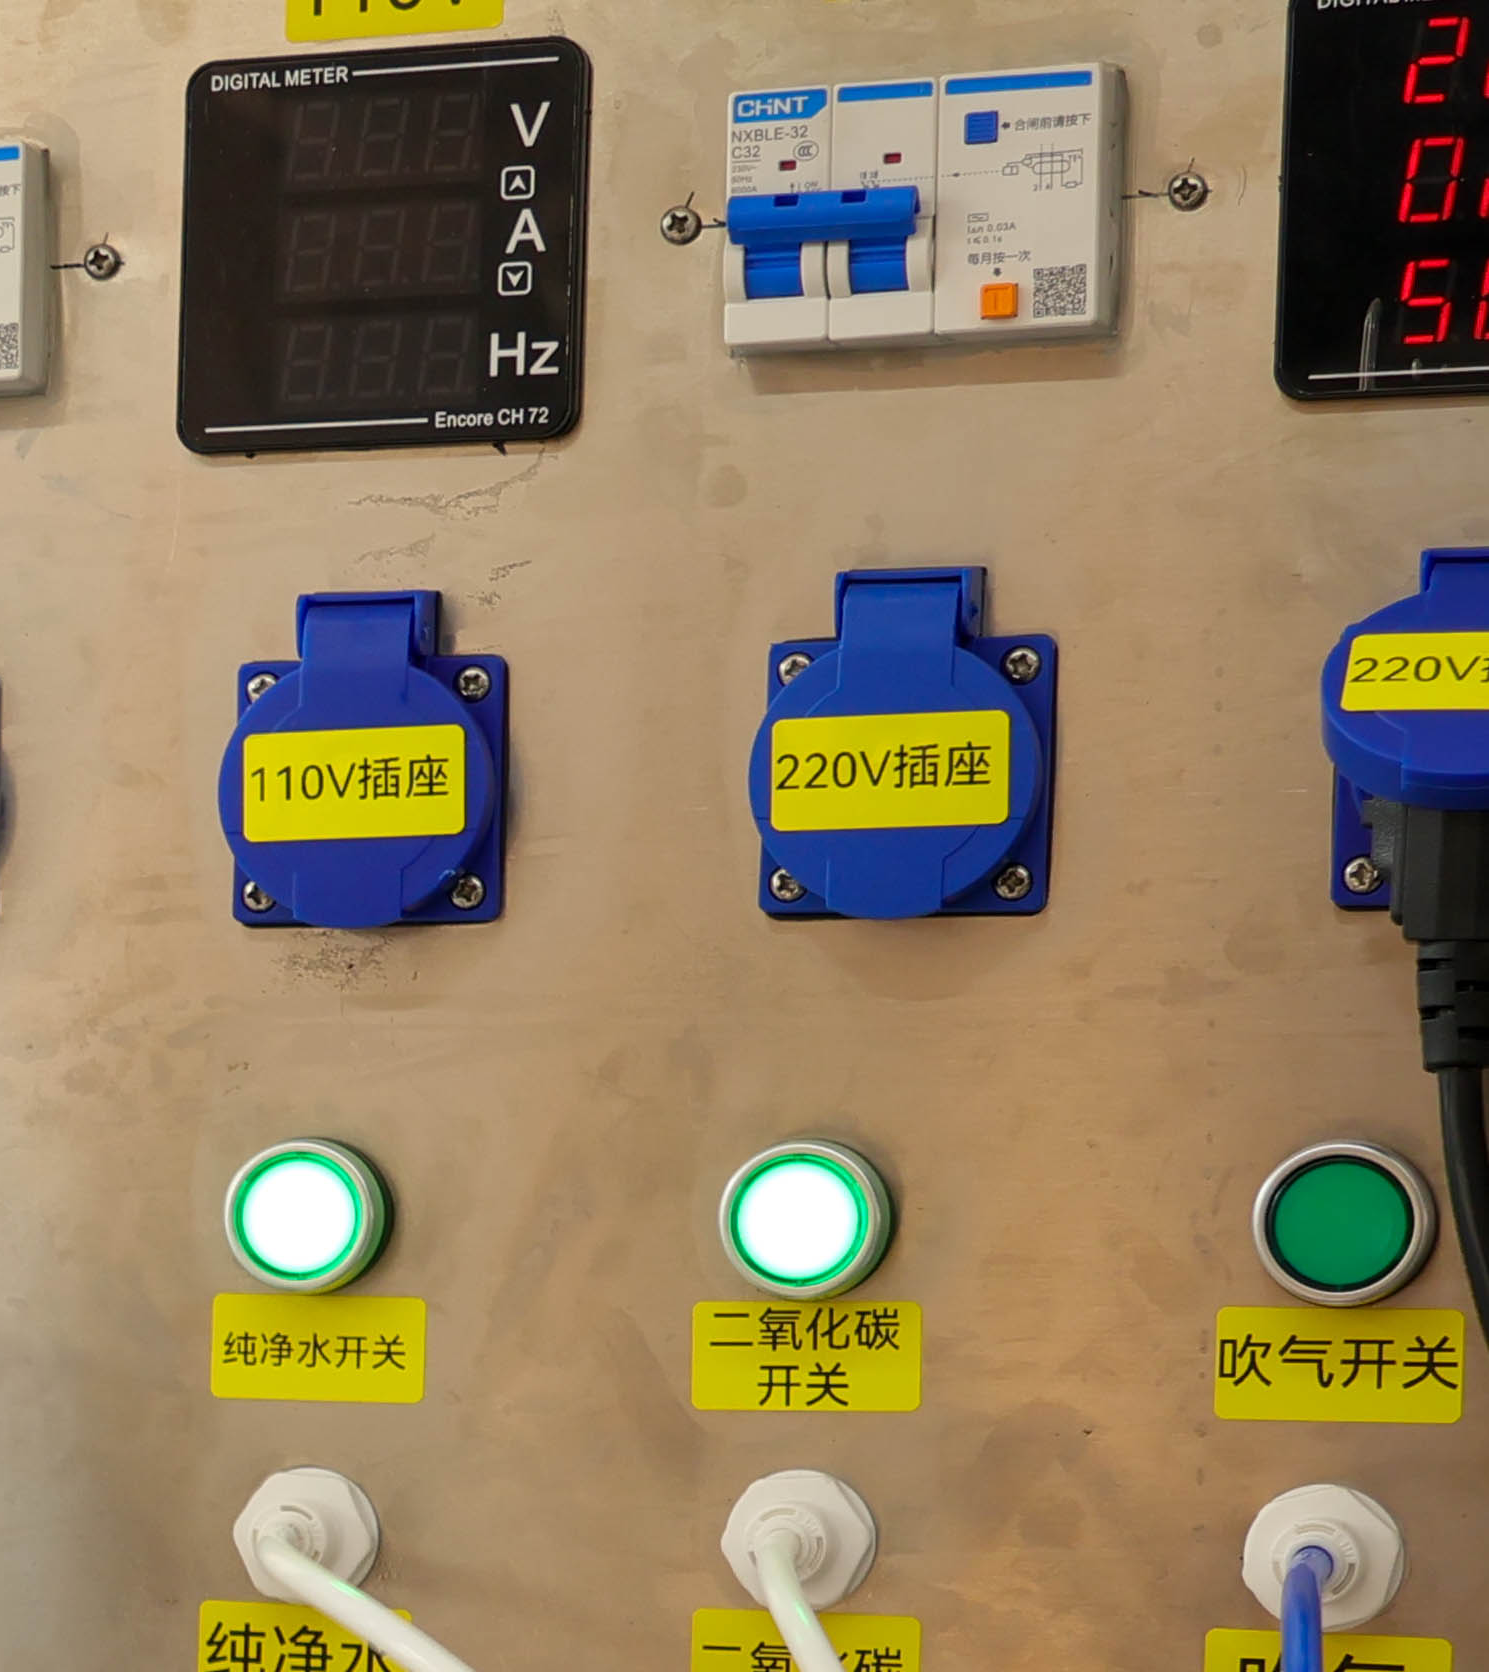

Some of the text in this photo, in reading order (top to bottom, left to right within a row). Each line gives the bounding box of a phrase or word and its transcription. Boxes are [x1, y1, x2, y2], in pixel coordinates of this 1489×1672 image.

[210, 67, 349, 92] DIGITAL METER
[510, 101, 551, 148] V
[731, 125, 808, 143] NXBLE-32
[731, 145, 761, 160] C32
[505, 208, 548, 255] A
[488, 331, 561, 377] Hz
[434, 406, 549, 430] Encore CH 72
[251, 754, 451, 802] 110V插座
[775, 741, 992, 792] 220V插座
[222, 1331, 407, 1371] 纯净水开关
[708, 1306, 901, 1354] 二氧化碳
[757, 1361, 850, 1408] 开关
[1218, 1333, 1461, 1391] 吹气开关
